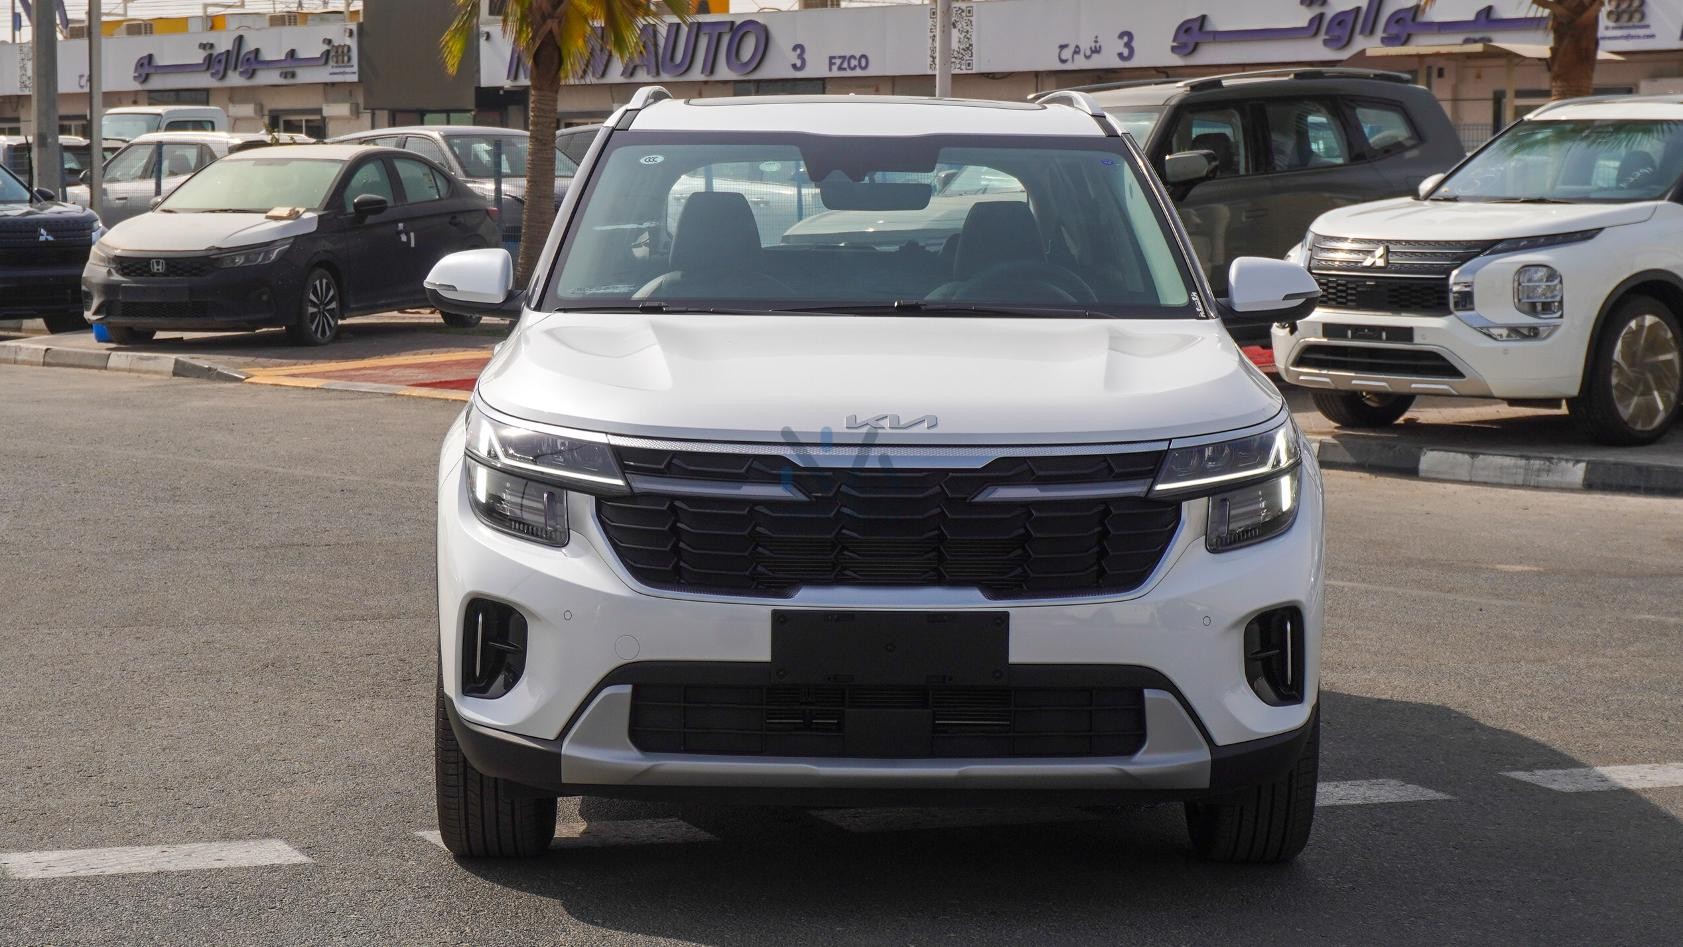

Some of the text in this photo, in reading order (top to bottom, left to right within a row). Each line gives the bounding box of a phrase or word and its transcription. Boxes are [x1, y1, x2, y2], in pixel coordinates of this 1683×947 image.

[620, 20, 769, 77] AUTO
[791, 43, 807, 72] 3
[828, 54, 870, 72] FZCO
[1116, 30, 1136, 62] 3
